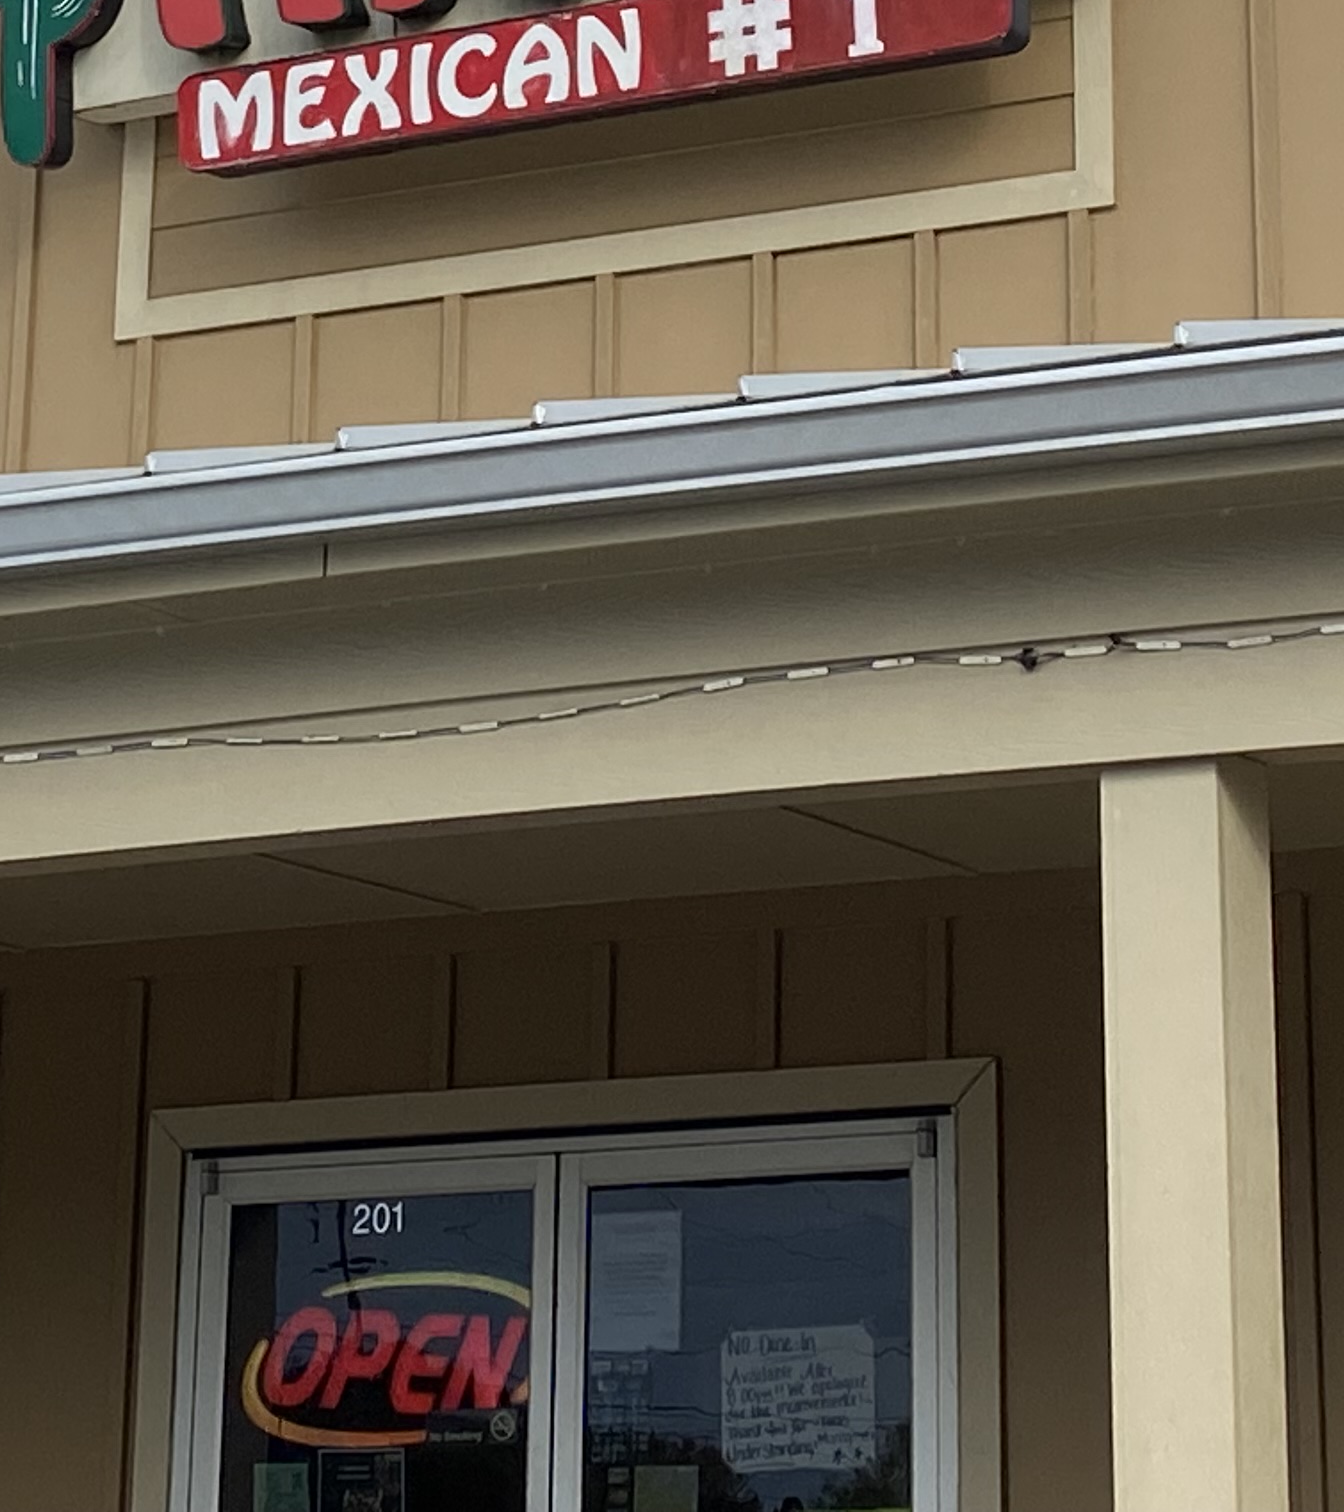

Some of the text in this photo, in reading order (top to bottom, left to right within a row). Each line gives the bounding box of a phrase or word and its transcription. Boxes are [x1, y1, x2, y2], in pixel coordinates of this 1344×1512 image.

[197, 7, 642, 161] MEXICAN
[352, 1201, 404, 1236] 201
[263, 1305, 527, 1414] OPEN
